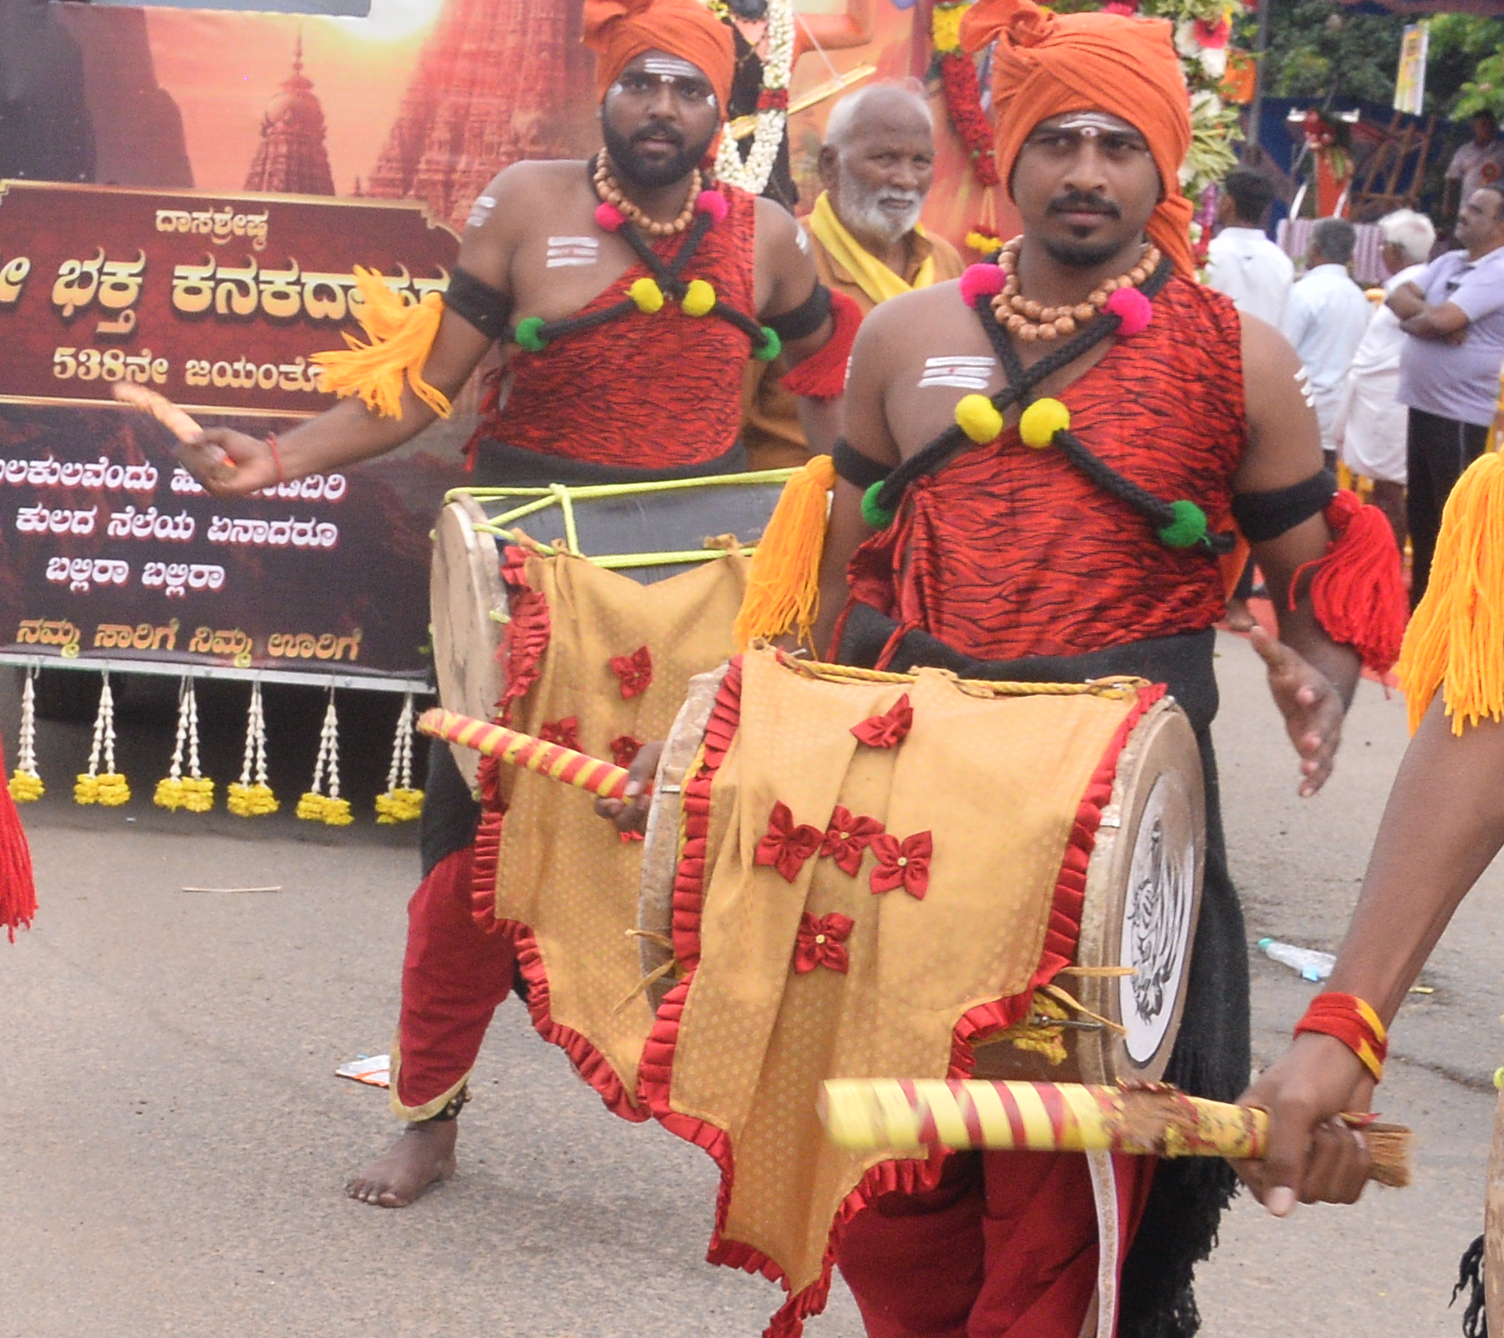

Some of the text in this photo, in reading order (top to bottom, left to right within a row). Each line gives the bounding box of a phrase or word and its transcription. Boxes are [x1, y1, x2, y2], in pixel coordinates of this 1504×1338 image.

[156, 206, 270, 250] ದಾಸಶ್ರೇಷ್ಠ
[52, 246, 146, 333] ಭಕ್ತ
[54, 347, 169, 385] 538ನೇ
[16, 502, 98, 535] ಕುಲದ
[108, 506, 195, 540] ನೆಲೆಯ
[207, 515, 338, 547] ಏನಾದರೂ
[46, 556, 226, 596] ಬಲ್ಲಿರಾ ಬಲ್ಲಿರಾ
[16, 618, 363, 668] ನಮ್ಮ ಸಾರಿಗೆ ನಿಮ್ಮ ಊರಿಗೆ
